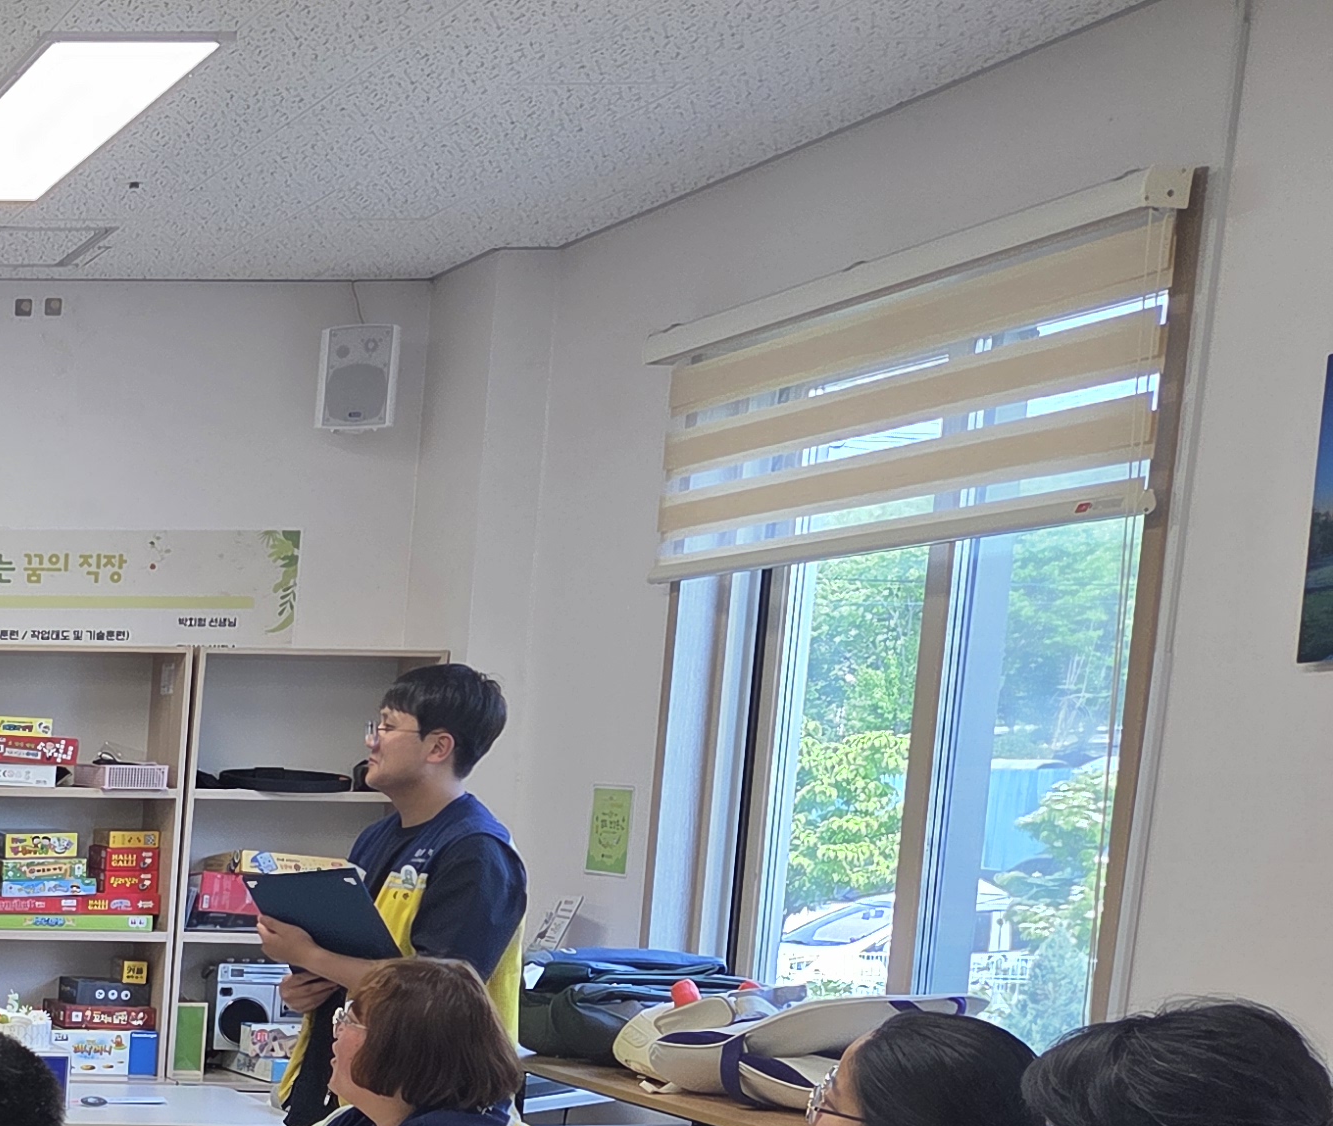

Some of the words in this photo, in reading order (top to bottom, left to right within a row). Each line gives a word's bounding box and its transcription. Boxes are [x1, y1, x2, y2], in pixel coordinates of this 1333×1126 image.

[23, 553, 70, 584] 꿈의
[78, 553, 128, 584] 직장
[209, 617, 237, 627] 선생님
